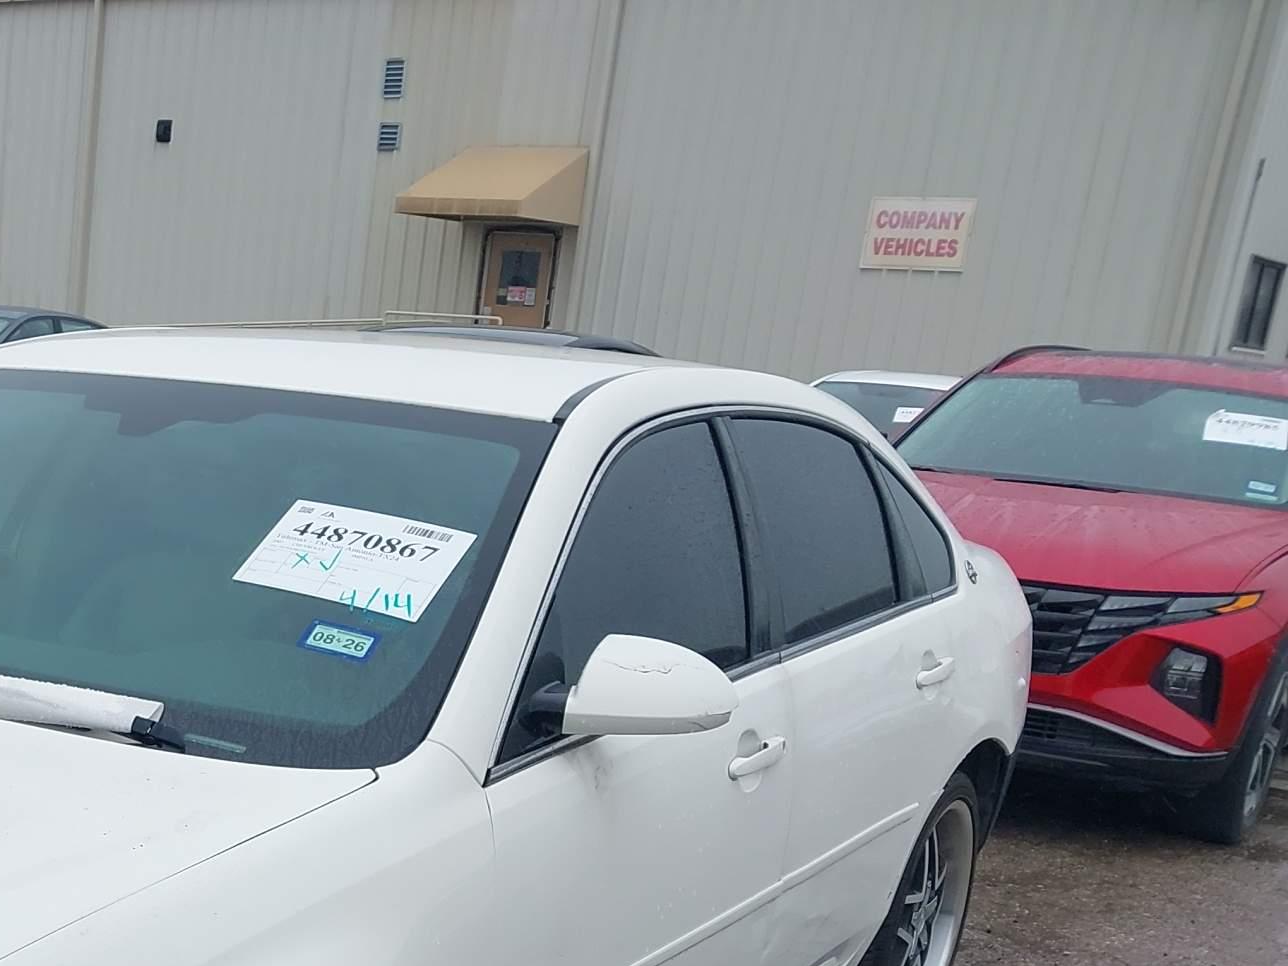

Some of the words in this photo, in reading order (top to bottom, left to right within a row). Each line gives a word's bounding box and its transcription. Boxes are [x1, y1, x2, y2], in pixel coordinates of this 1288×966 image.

[876, 209, 966, 231] COMPANY
[872, 236, 960, 258] VEHICLES
[292, 521, 441, 563] 44870867
[339, 587, 413, 617] 4/14
